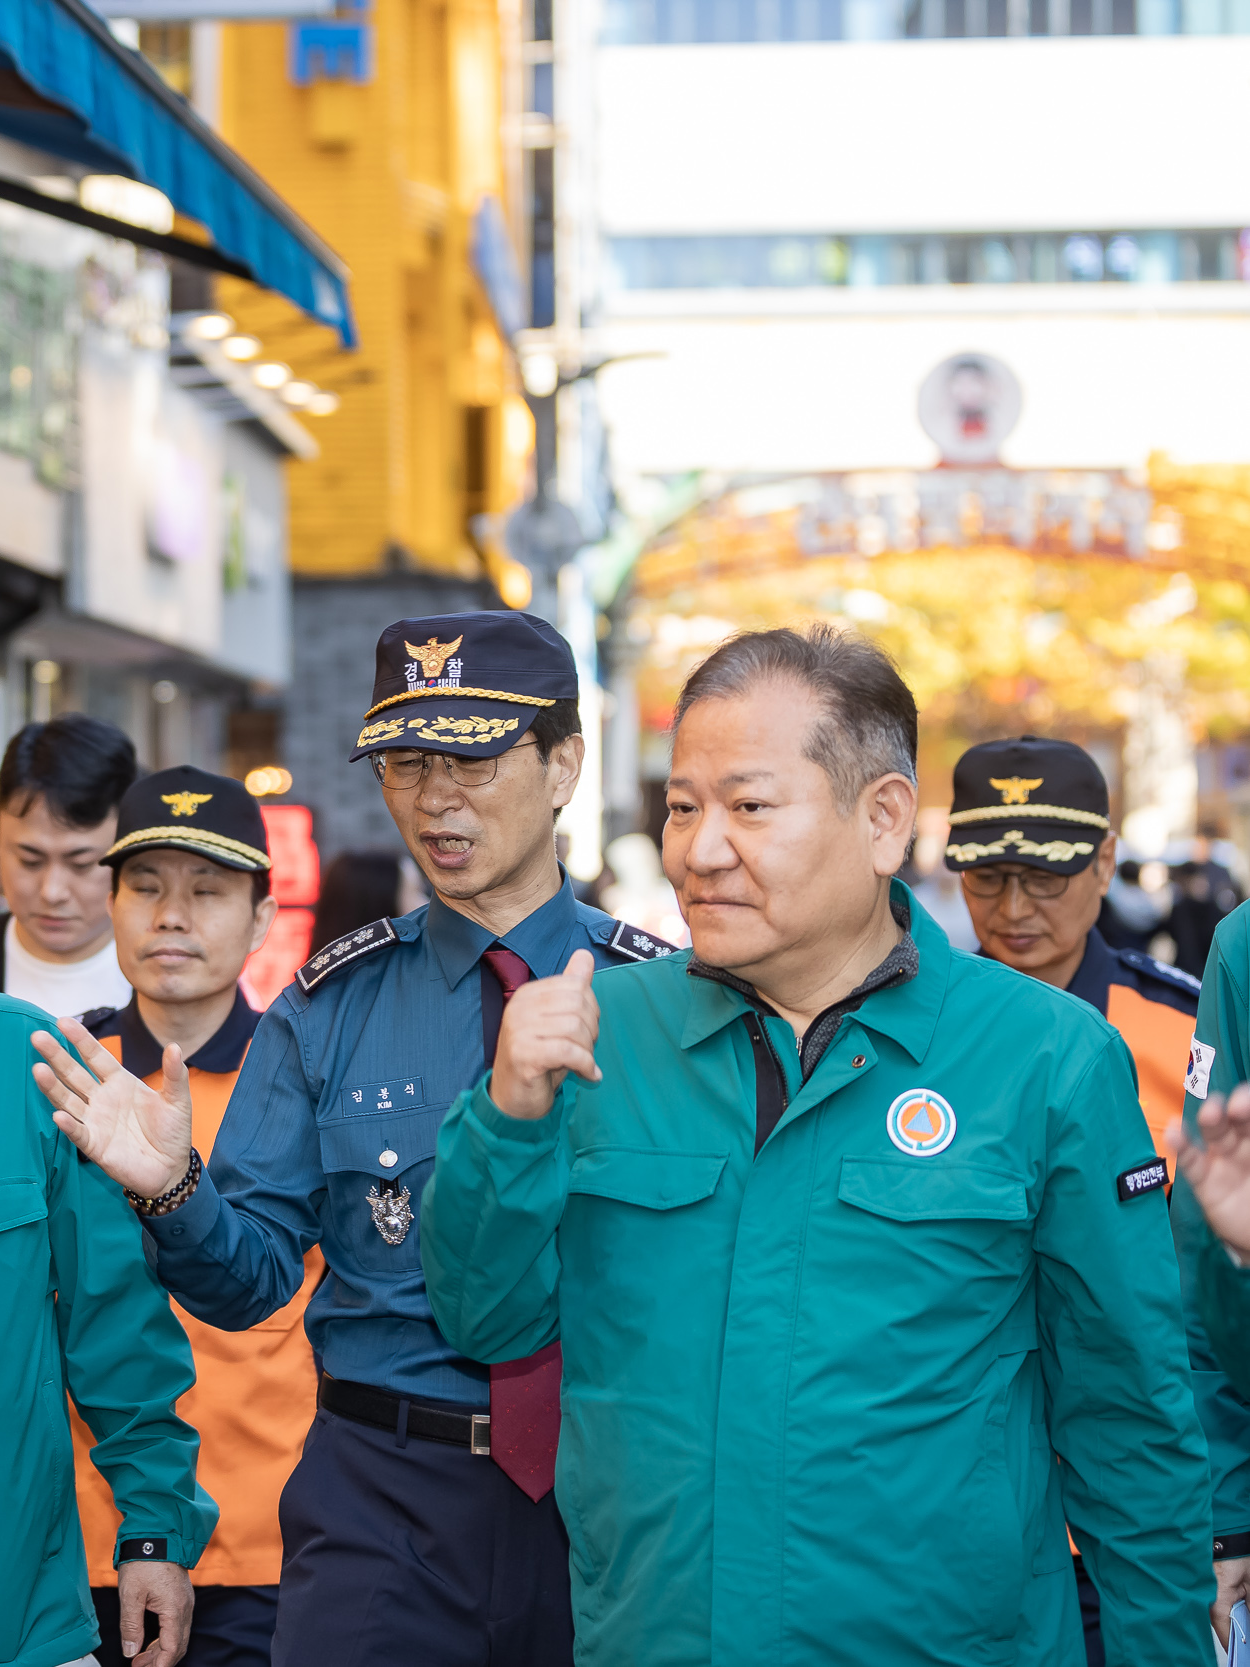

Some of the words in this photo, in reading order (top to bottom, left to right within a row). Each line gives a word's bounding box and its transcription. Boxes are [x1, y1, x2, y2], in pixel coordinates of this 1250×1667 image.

[404, 661, 418, 682] 경
[446, 657, 464, 678] 찰
[376, 1100, 393, 1110] KIM
[1125, 1164, 1165, 1192] 행정안전부
